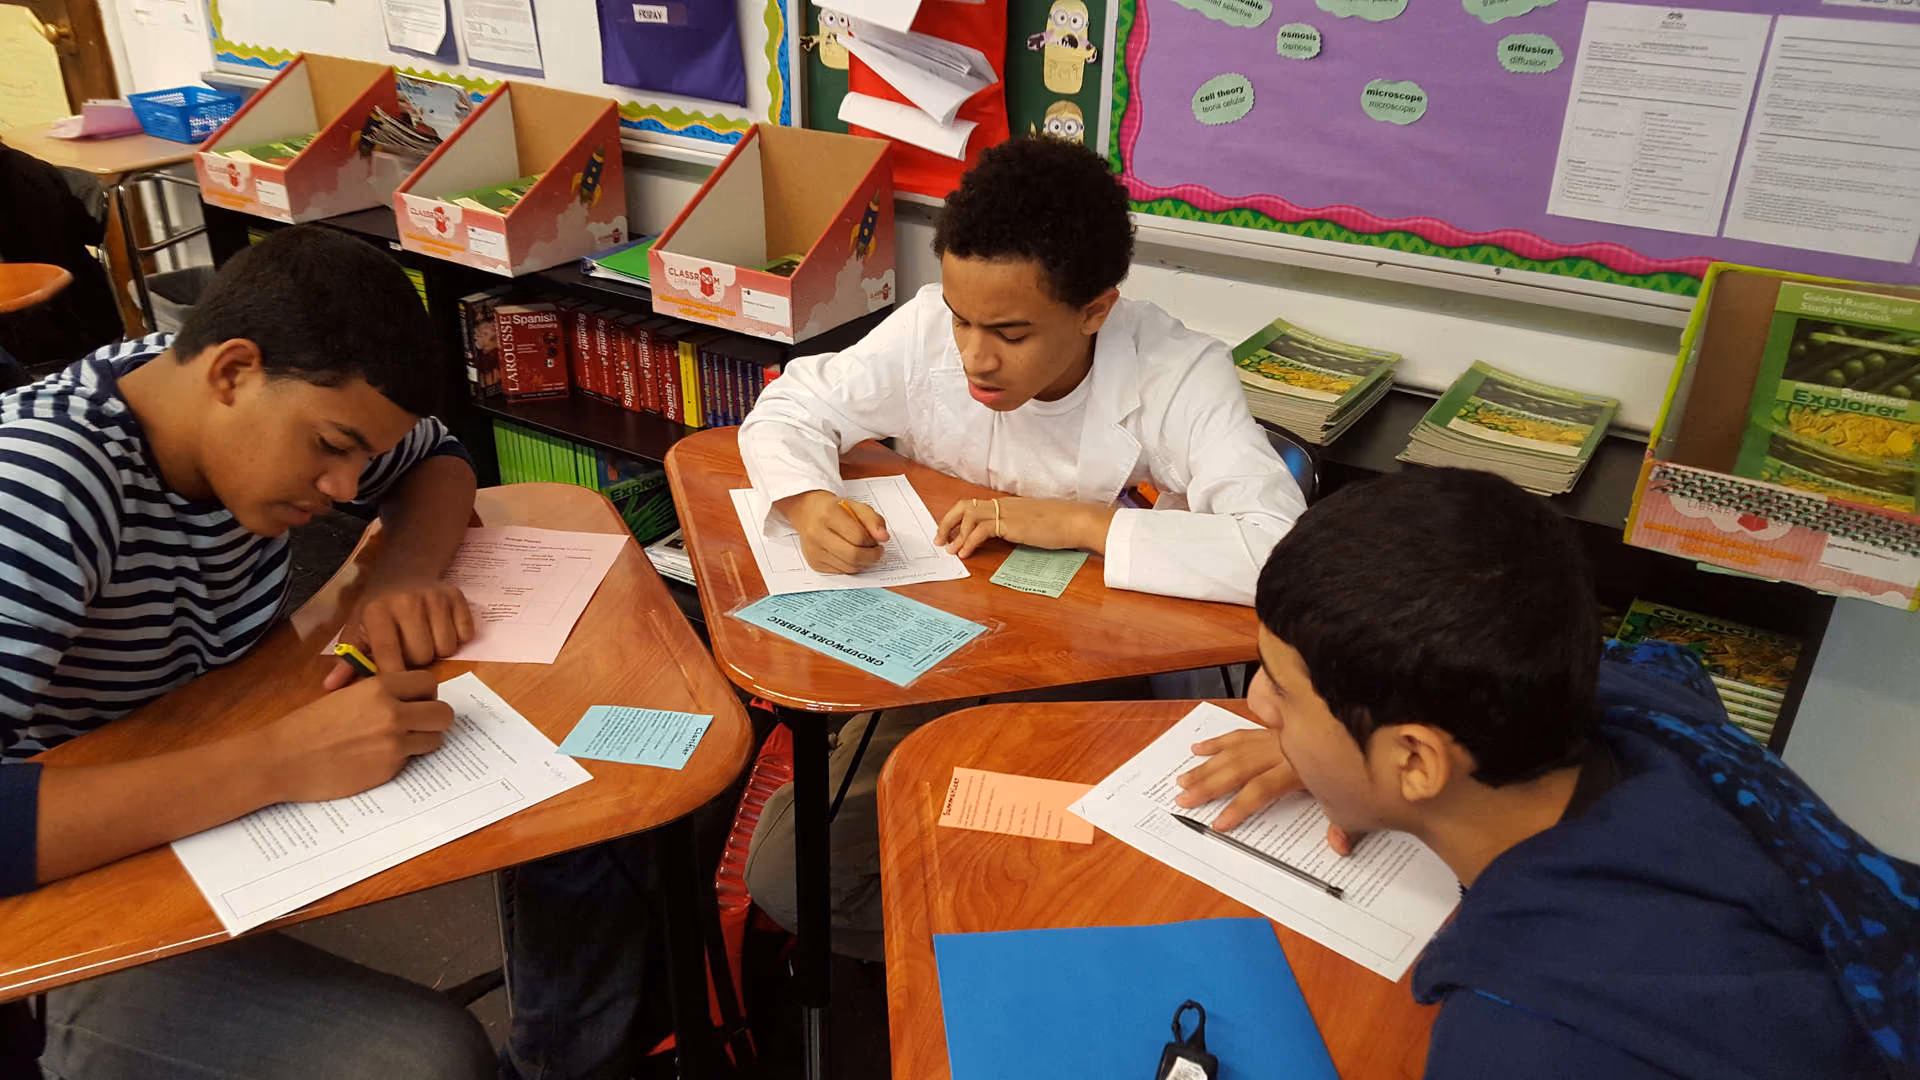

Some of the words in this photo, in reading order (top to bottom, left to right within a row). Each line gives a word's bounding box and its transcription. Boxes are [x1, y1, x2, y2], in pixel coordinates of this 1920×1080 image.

[1281, 31, 1317, 41] osmosis
[1507, 43, 1554, 55] diffusion
[1200, 92, 1215, 103] cell
[1217, 85, 1244, 98] theory
[1366, 89, 1423, 103] microscope
[668, 267, 720, 285] CLASSROOM
[1802, 292, 1842, 305] Guided
[1800, 302, 1831, 314] Study
[512, 313, 557, 326] Spanish
[500, 315, 520, 391] LAROUSSE
[621, 370, 632, 407] Spanish
[1841, 388, 1908, 407] Science
[664, 382, 675, 420] Spanish
[1793, 389, 1906, 417] Explorer
[767, 615, 809, 637] RUBRIC
[808, 631, 885, 667] GROUPWORK
[683, 727, 703, 756] Clarifier
